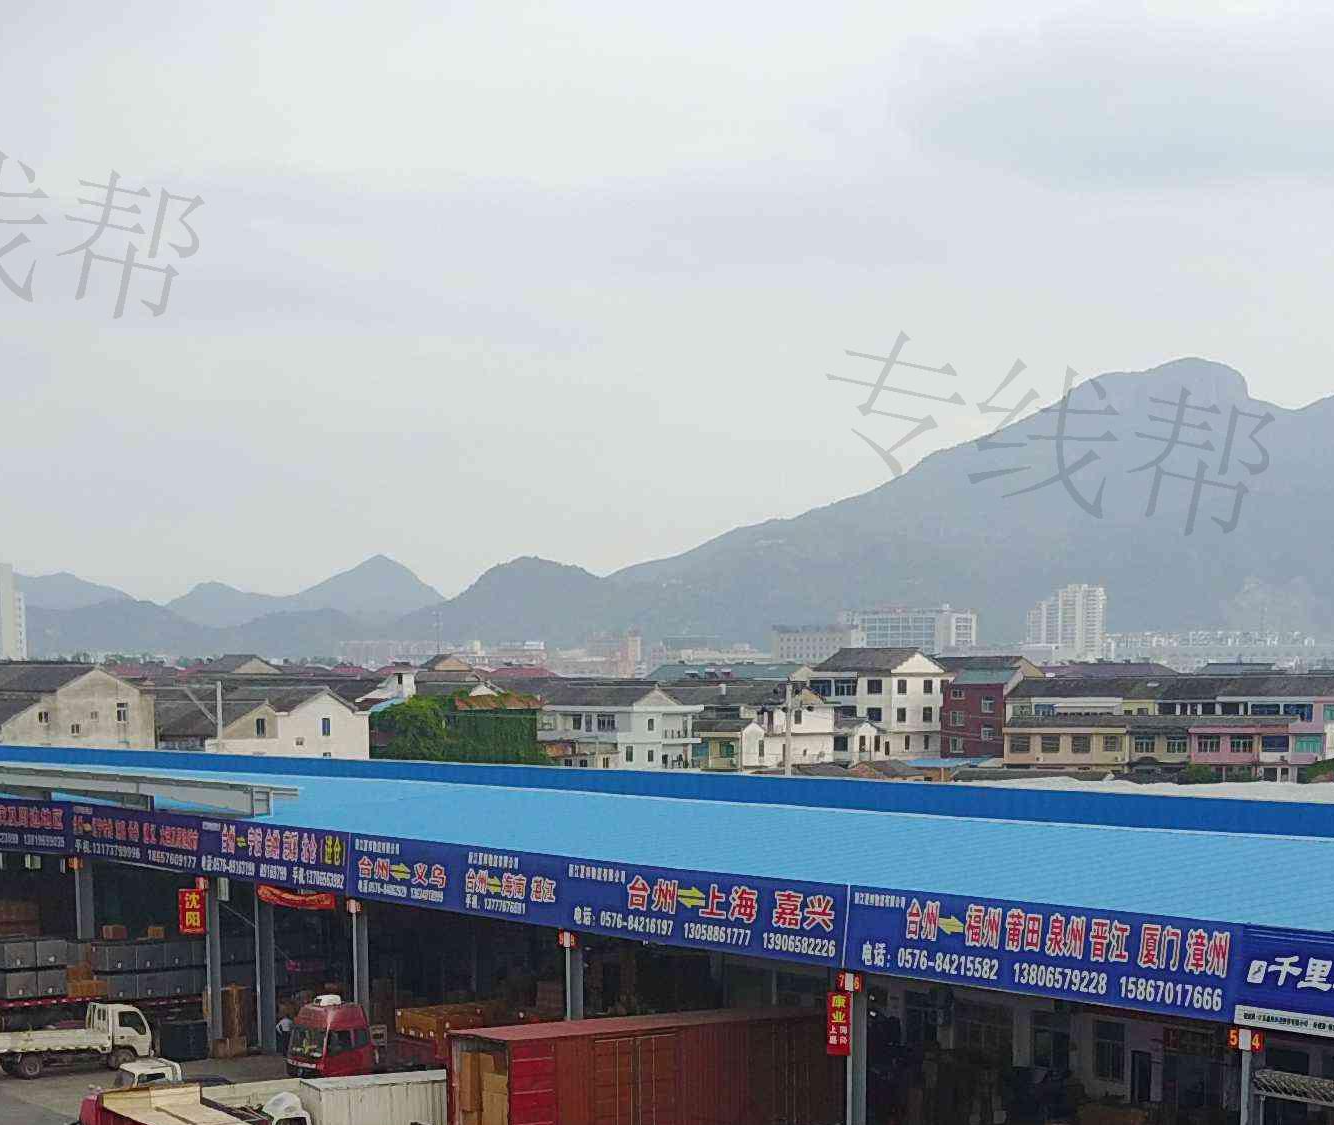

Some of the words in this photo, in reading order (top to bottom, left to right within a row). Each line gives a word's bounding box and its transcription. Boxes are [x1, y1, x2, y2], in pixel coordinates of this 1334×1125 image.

[358, 856, 390, 880] 台州
[411, 862, 446, 888] 义乌
[466, 868, 488, 894] 台州
[627, 875, 679, 914] 台州
[699, 884, 758, 923] 上海
[772, 891, 835, 932] 嘉兴
[906, 898, 940, 941] 台州
[965, 904, 1002, 949] 福州
[1006, 908, 1042, 951] 莆田
[1045, 912, 1086, 959] 泉州
[1089, 918, 1130, 962] 晋江
[1137, 923, 1182, 971] 厦门
[1184, 928, 1230, 978] 漳州
[1013, 962, 1107, 995] 13806579228
[1120, 976, 1222, 1011] 15867017666
[1229, 1030, 1238, 1045] 5
[1251, 1034, 1260, 1049] 4
